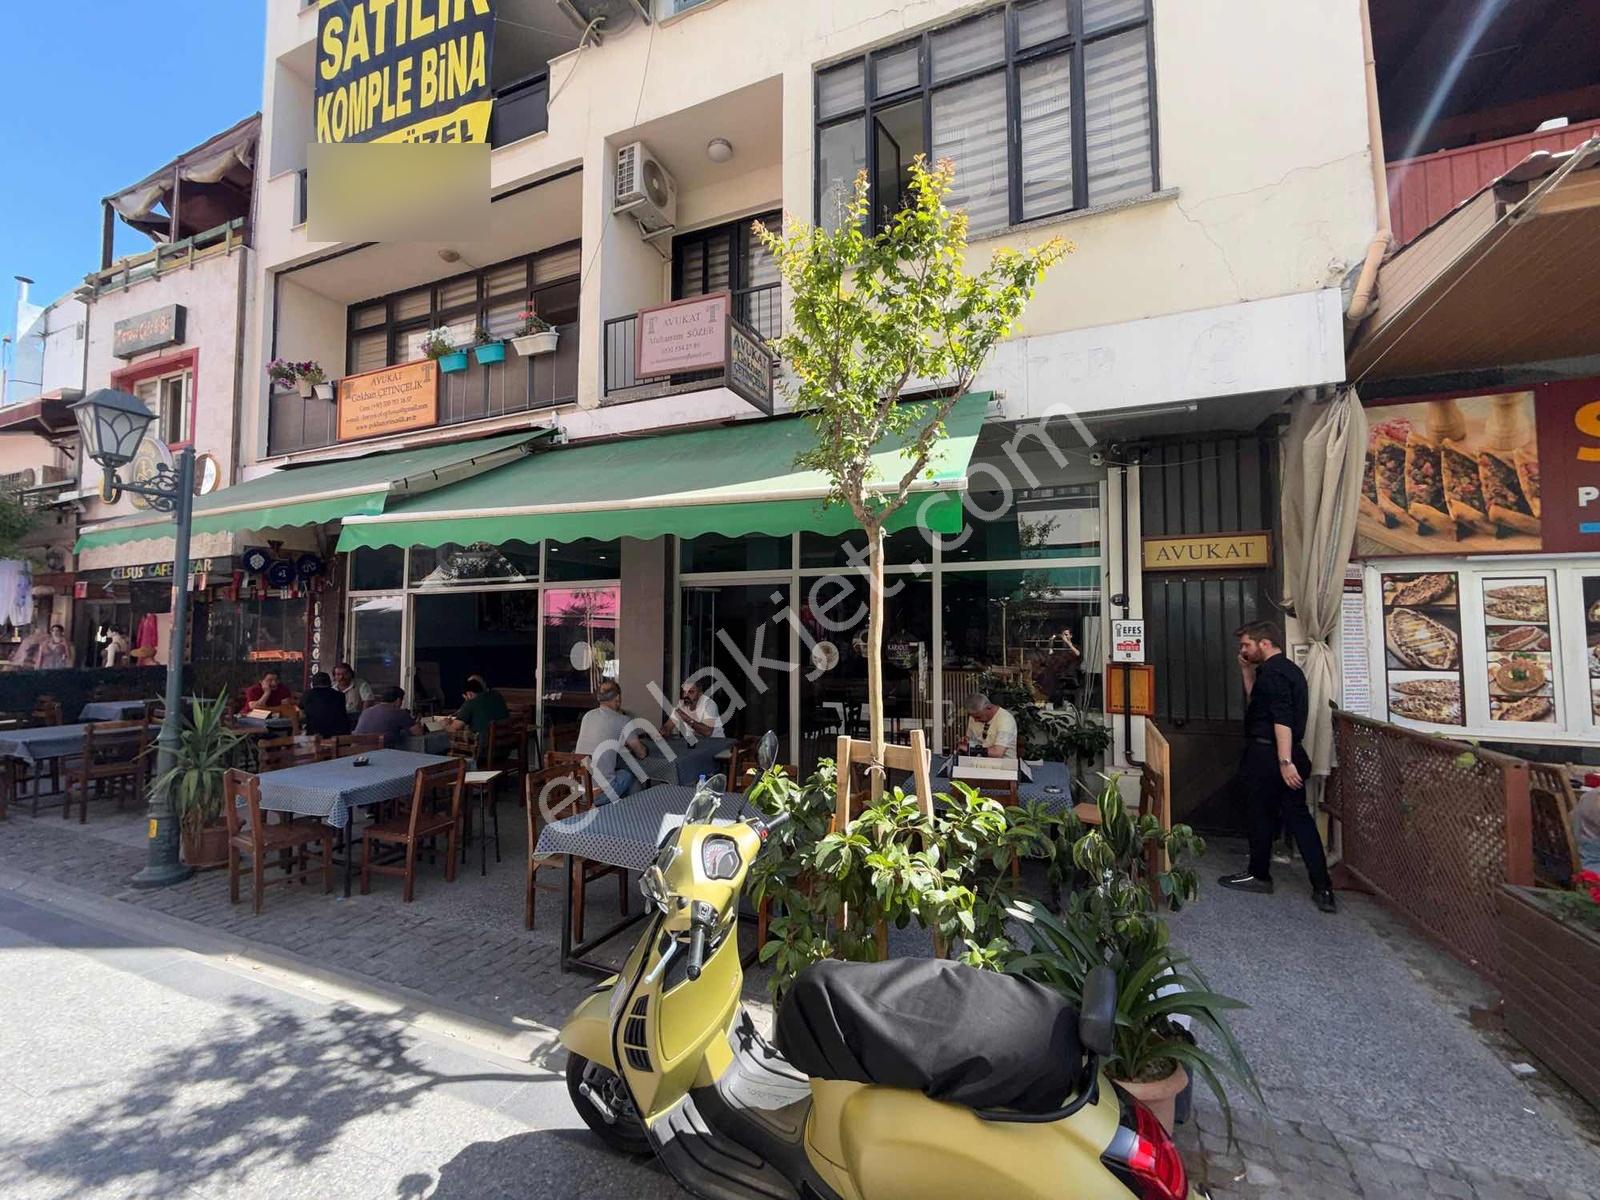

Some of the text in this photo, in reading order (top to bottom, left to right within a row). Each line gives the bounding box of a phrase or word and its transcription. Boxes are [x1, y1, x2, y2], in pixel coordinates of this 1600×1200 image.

[317, 56, 413, 143] KOMPLE
[664, 312, 702, 327] AVUKAT
[371, 371, 402, 386] AVUKAT
[1156, 542, 1255, 560] AVUKAT
[110, 566, 145, 579] CELSUS
[147, 563, 174, 577] CAFE
[1122, 626, 1142, 634] EFES
